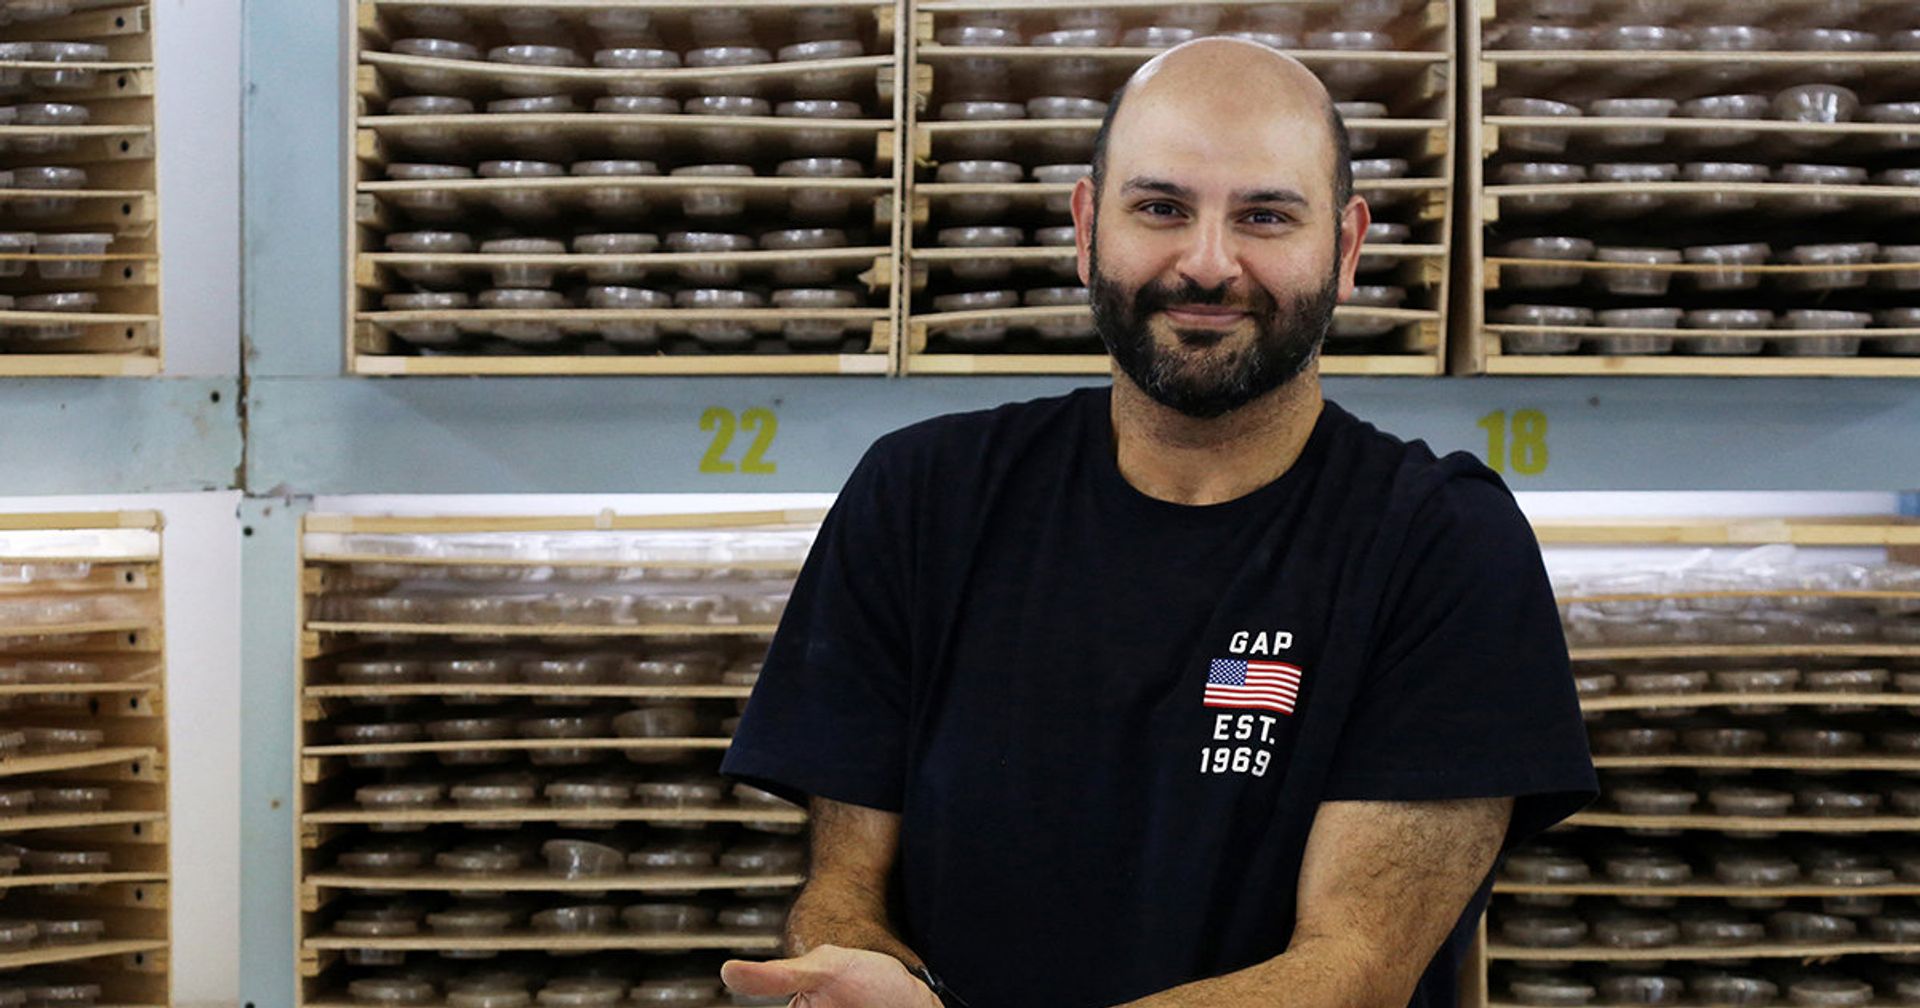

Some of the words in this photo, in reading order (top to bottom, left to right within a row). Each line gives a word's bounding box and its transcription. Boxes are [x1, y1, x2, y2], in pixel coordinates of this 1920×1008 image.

[699, 407, 777, 473] 22
[1477, 409, 1548, 475] 18
[1229, 631, 1293, 655] GAP
[1213, 714, 1277, 744] EST.
[1200, 747, 1271, 777] 1969
